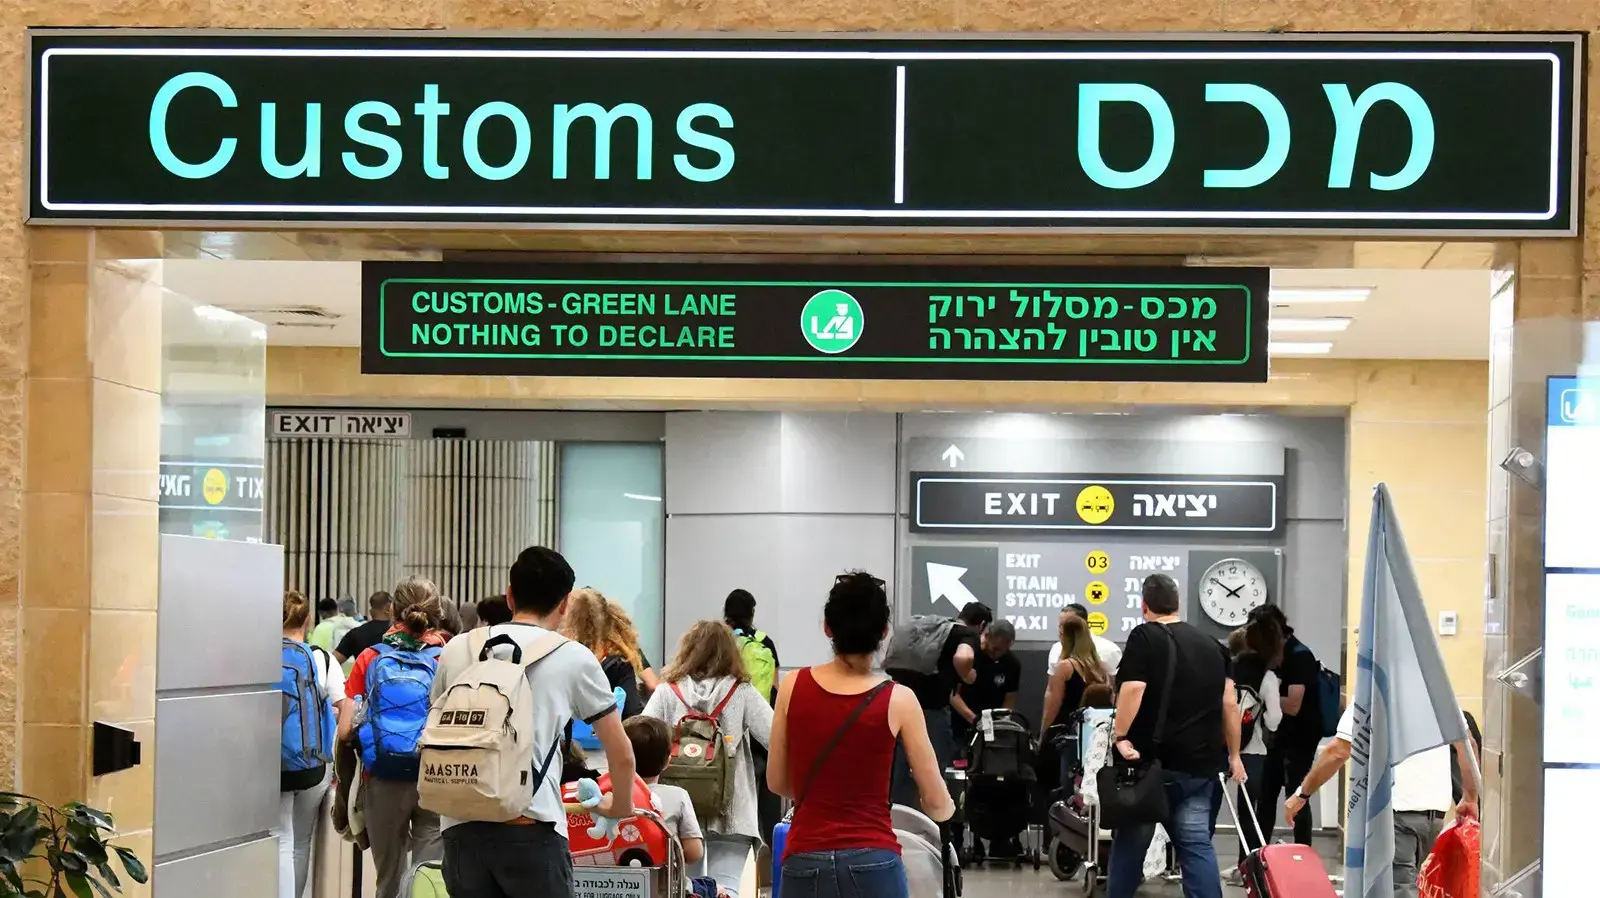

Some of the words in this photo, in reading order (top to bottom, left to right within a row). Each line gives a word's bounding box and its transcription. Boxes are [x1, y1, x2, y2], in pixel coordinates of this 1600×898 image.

[149, 72, 735, 182] Customs
[1078, 82, 1435, 191] מכס
[664, 294, 736, 315] LANE
[929, 296, 995, 323] ירוק
[412, 323, 540, 346] NOTHING
[550, 325, 588, 347] TO
[599, 325, 735, 348] DECLARE
[929, 322, 1067, 350] להצהרה
[1079, 329, 1157, 357] טובין
[1171, 329, 1216, 358] אין
[280, 415, 335, 433] EXIT
[348, 416, 403, 433] יציאה
[985, 492, 1060, 515] EXIT
[1133, 494, 1217, 517] יציאה
[1006, 553, 1041, 568] EXIT
[1088, 556, 1107, 568] 03
[1130, 555, 1180, 570] יציאה
[1006, 575, 1058, 590] TRAIN
[1005, 593, 1075, 608] STATION
[1005, 615, 1047, 630] TAXI
[583, 878, 614, 888] לכבודה
[617, 879, 640, 889] עגלה
